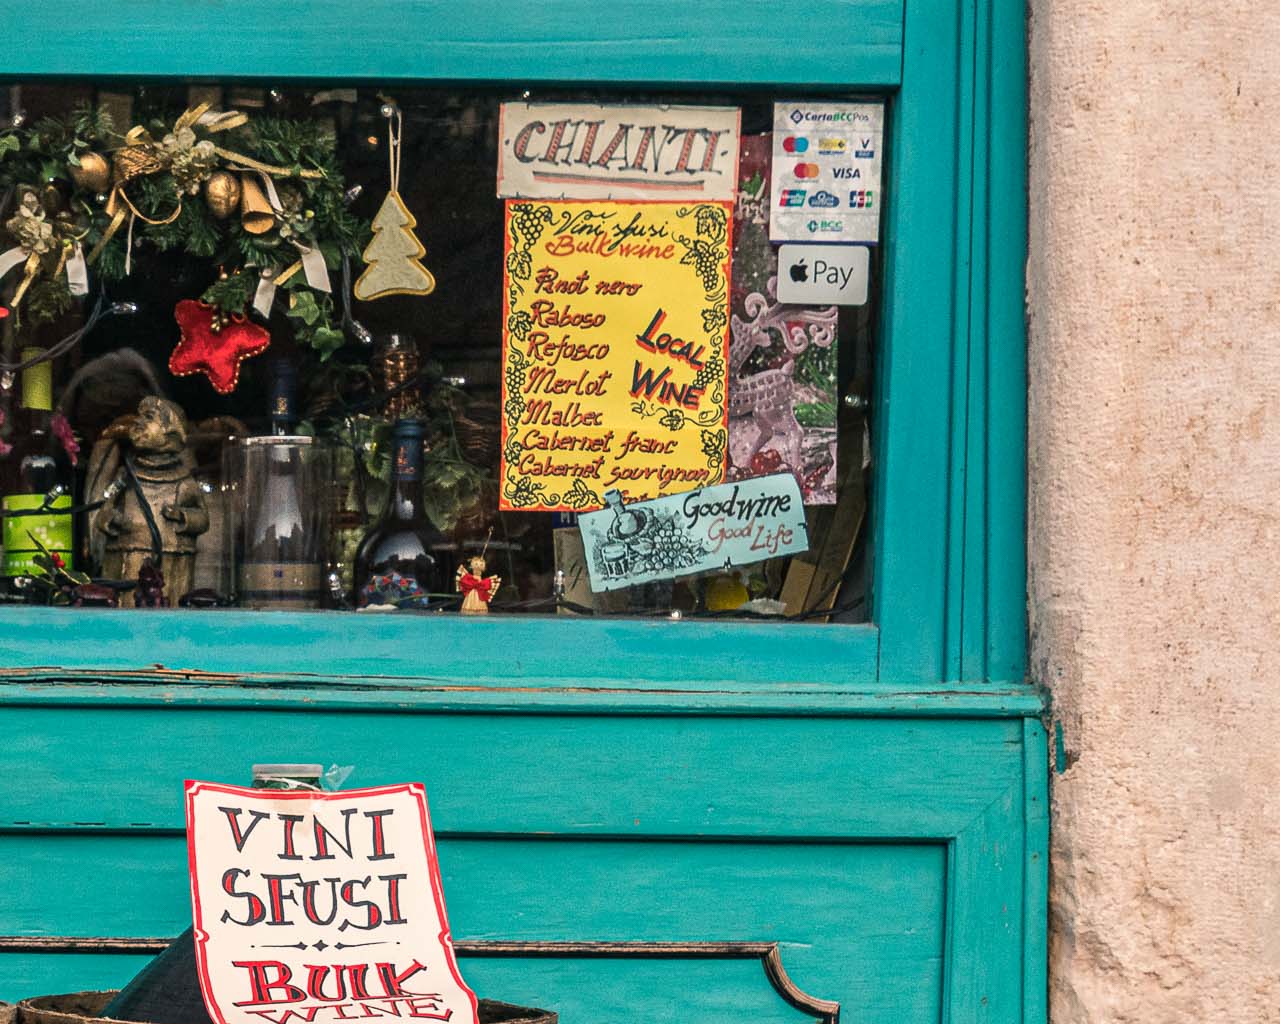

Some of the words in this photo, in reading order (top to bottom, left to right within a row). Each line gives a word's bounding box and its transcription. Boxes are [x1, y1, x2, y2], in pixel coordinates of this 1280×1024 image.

[513, 118, 729, 175] CHIANTI
[832, 168, 860, 178] VISA
[545, 232, 616, 257] Bulk
[620, 238, 675, 259] wine
[553, 210, 617, 236] Vini
[608, 212, 669, 251] sfusi
[595, 280, 643, 296] nero
[814, 260, 853, 290] Pay
[530, 299, 606, 329] Raboso
[526, 331, 610, 366] Refosco
[636, 308, 706, 371] LOCAL
[524, 366, 612, 397] Merlot
[629, 360, 706, 410] WINE
[521, 399, 603, 427] Malbec
[523, 428, 614, 453] Cabernet
[615, 430, 678, 460] franc
[518, 453, 605, 479] Cabernet
[683, 485, 739, 529] Good
[737, 493, 792, 520] wine
[708, 516, 756, 554] Good
[750, 523, 793, 554] Life
[218, 806, 396, 861] VINI
[220, 867, 407, 932] SFUSI
[232, 959, 442, 1005] BULK
